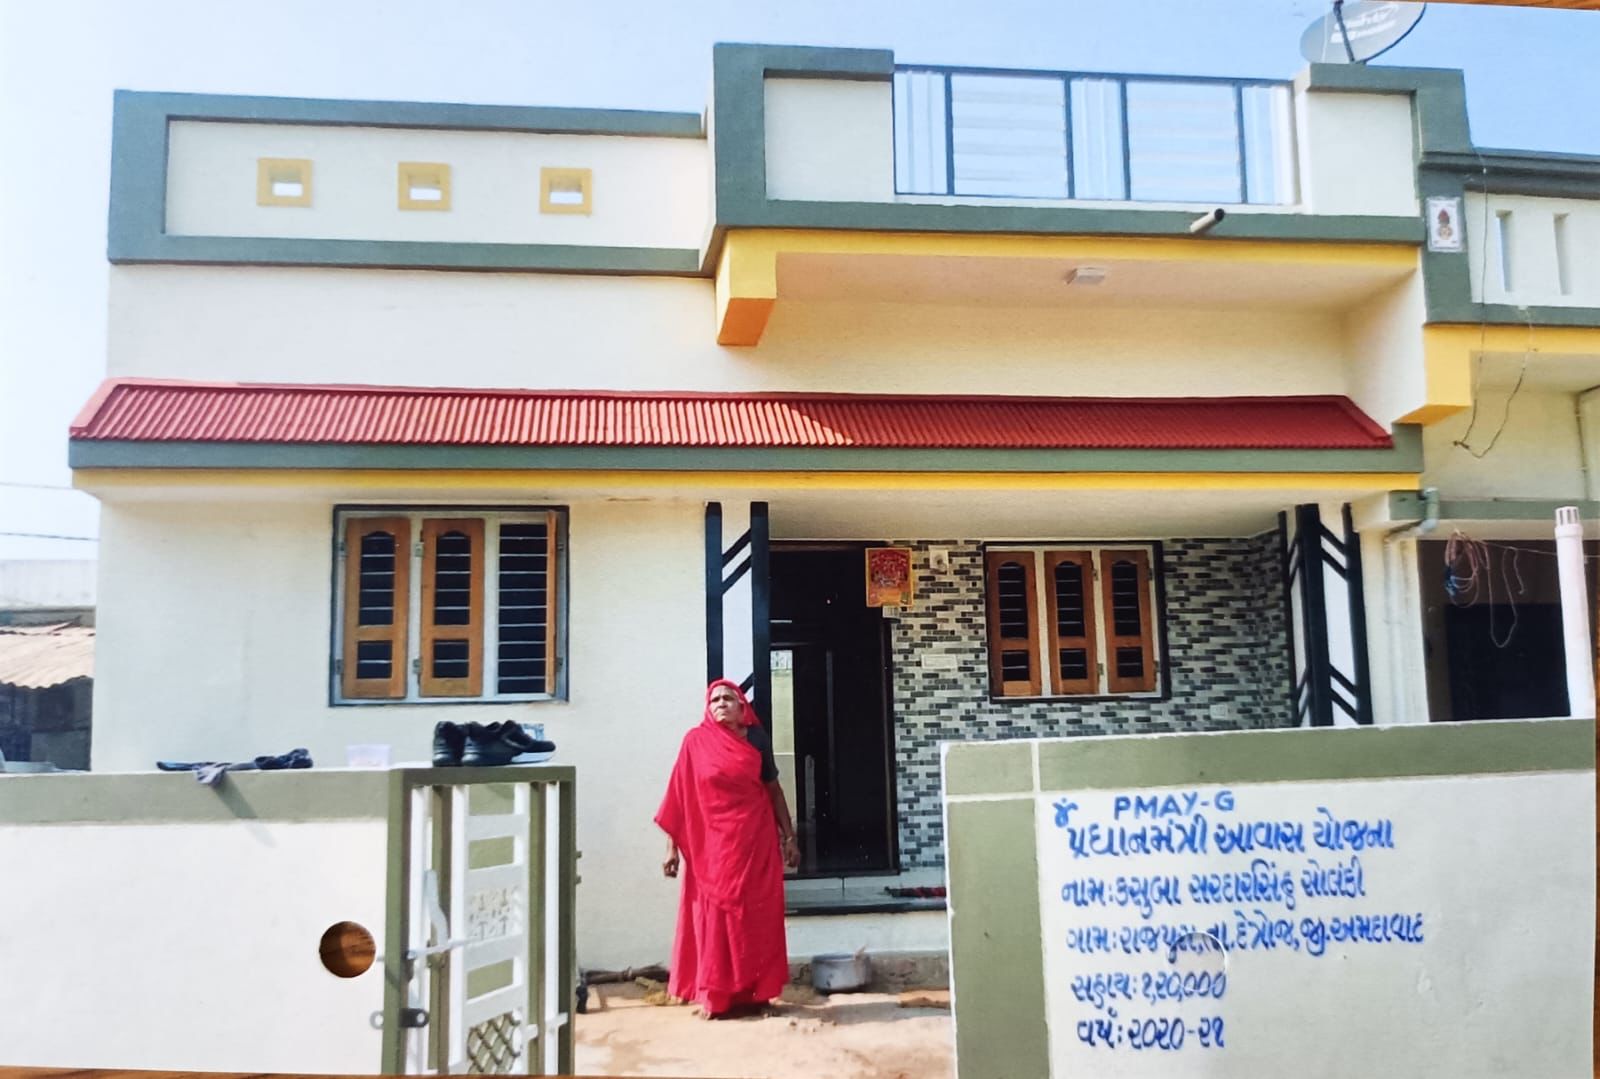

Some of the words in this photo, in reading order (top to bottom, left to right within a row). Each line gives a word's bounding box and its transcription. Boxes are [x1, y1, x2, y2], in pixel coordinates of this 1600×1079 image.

[1113, 790, 1235, 820] PMAY-G
[1213, 821, 1305, 854] આવાસ
[1313, 806, 1394, 850] યોજના
[1301, 854, 1366, 898] સોલંકી
